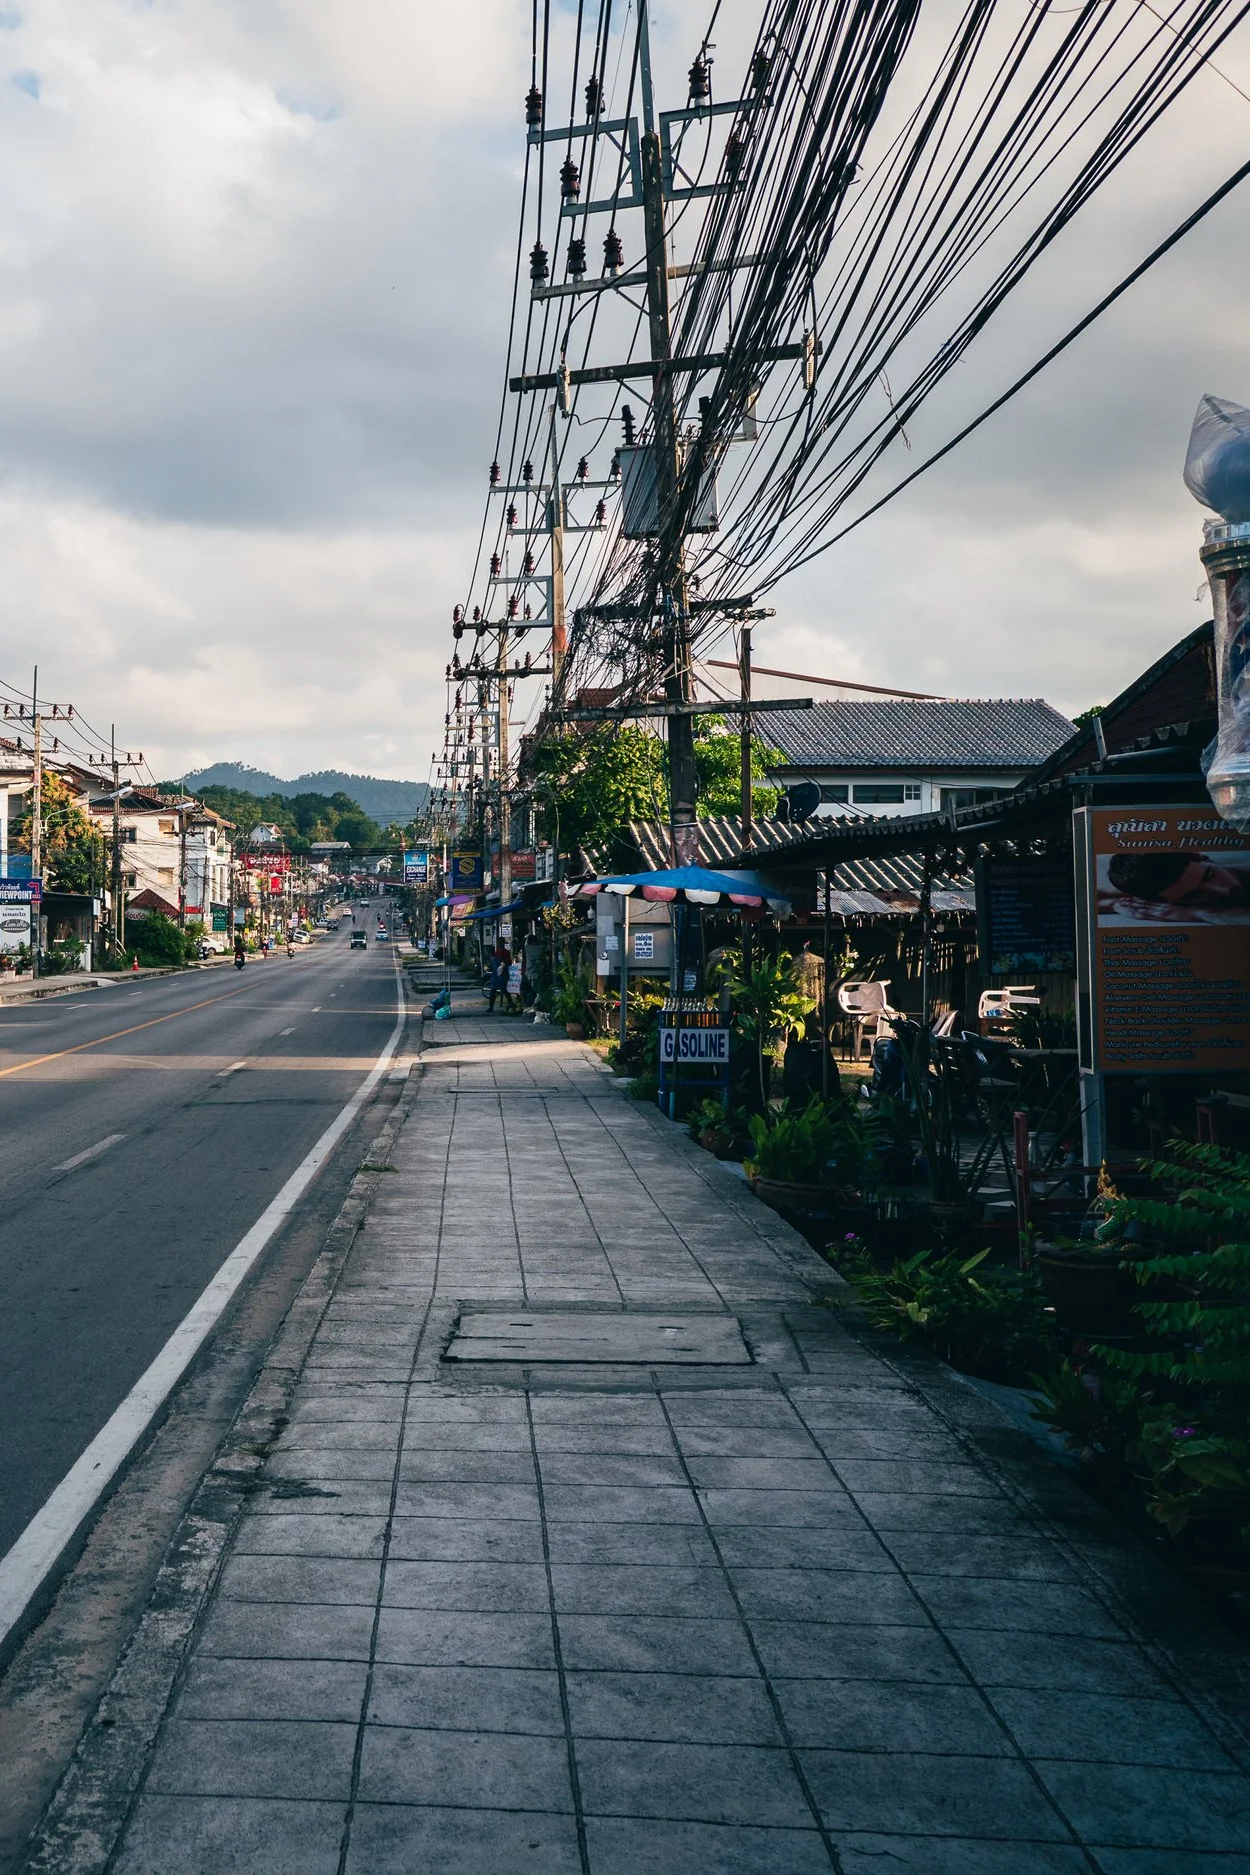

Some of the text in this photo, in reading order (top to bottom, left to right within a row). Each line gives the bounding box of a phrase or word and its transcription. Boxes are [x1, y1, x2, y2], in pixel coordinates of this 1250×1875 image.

[406, 865, 427, 873] EXCHANGE
[1102, 935, 1120, 943] Foot
[1122, 935, 1157, 944] Massage
[1102, 946, 1120, 954] Foot
[1103, 958, 1120, 966] Thai
[1121, 958, 1157, 968] Massage
[1117, 970, 1152, 979] Massage
[1103, 982, 1137, 990] Coconut
[1137, 982, 1174, 991] Massage
[1158, 994, 1194, 1003] Massage
[1141, 1006, 1178, 1015] Massage
[1104, 1017, 1125, 1025] Neck
[1185, 1017, 1221, 1027] Massage
[1104, 1029, 1127, 1037] Head
[1128, 1029, 1165, 1038] Massage
